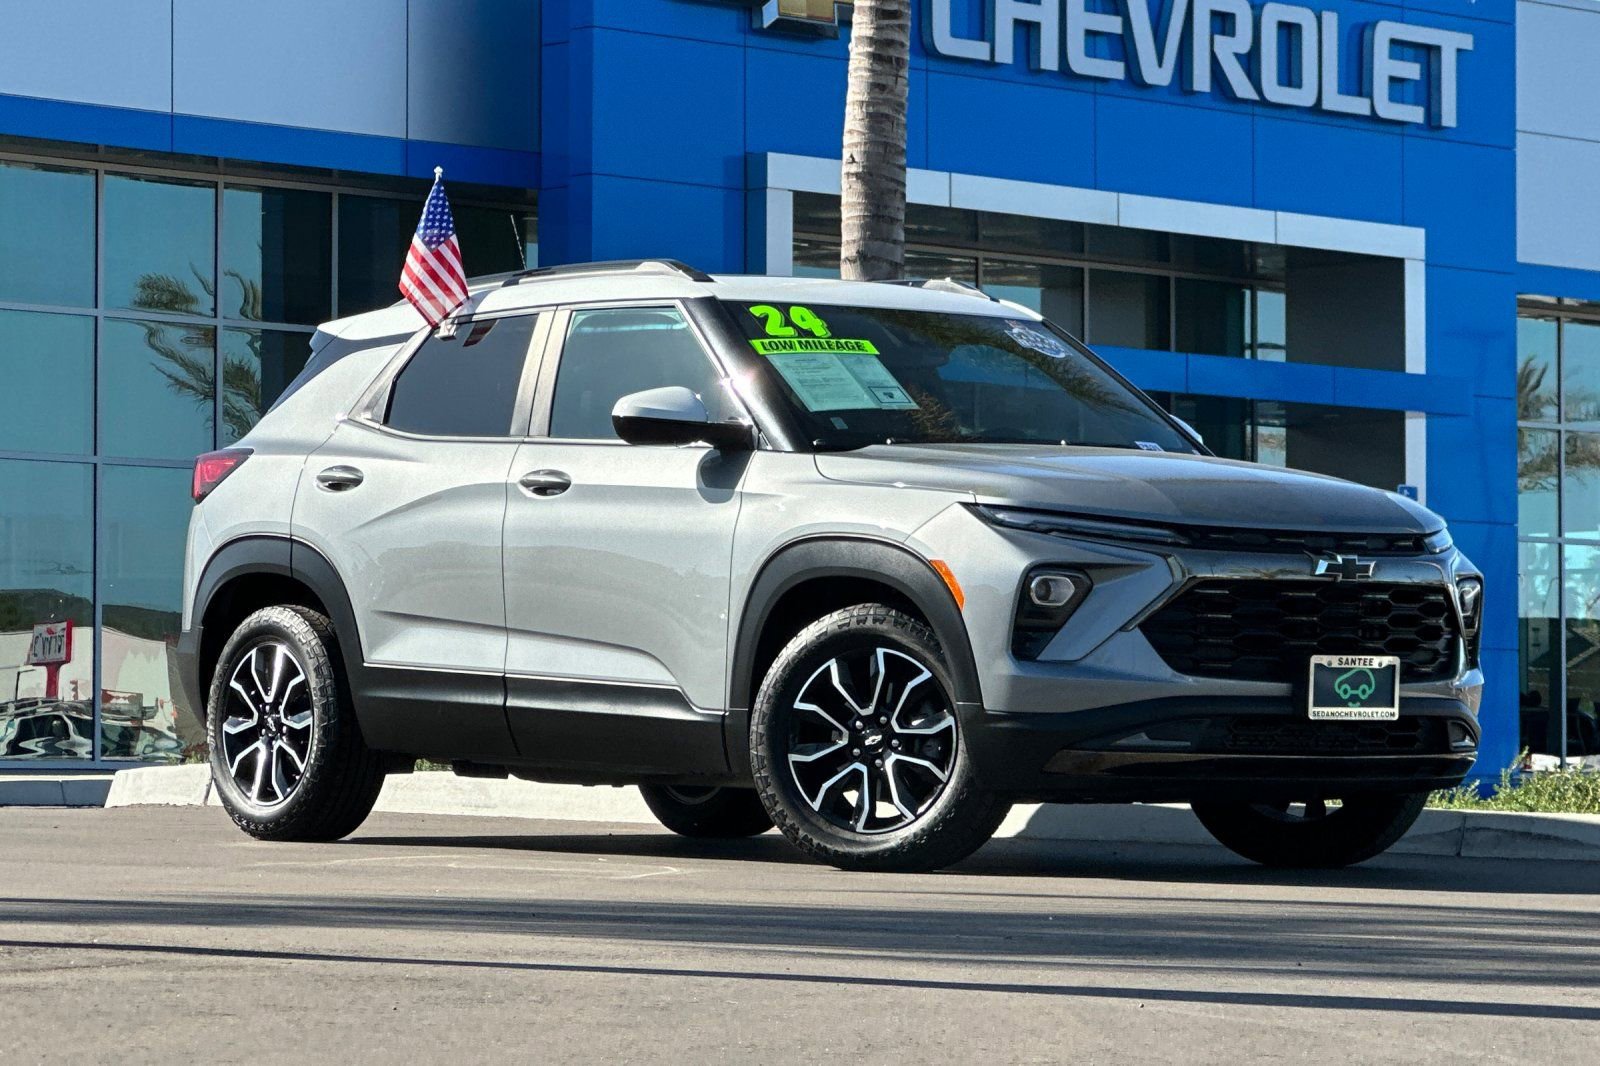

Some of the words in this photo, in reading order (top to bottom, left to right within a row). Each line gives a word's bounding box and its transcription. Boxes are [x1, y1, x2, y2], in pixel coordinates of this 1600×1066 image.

[930, 0, 1474, 128] CHEVROLET
[749, 304, 831, 337] 24
[760, 340, 796, 352] LOW
[799, 340, 868, 353] MILEAGE
[1337, 657, 1375, 667] SANTEE
[1312, 710, 1396, 718] SEDANOCHEVROLET.COM
